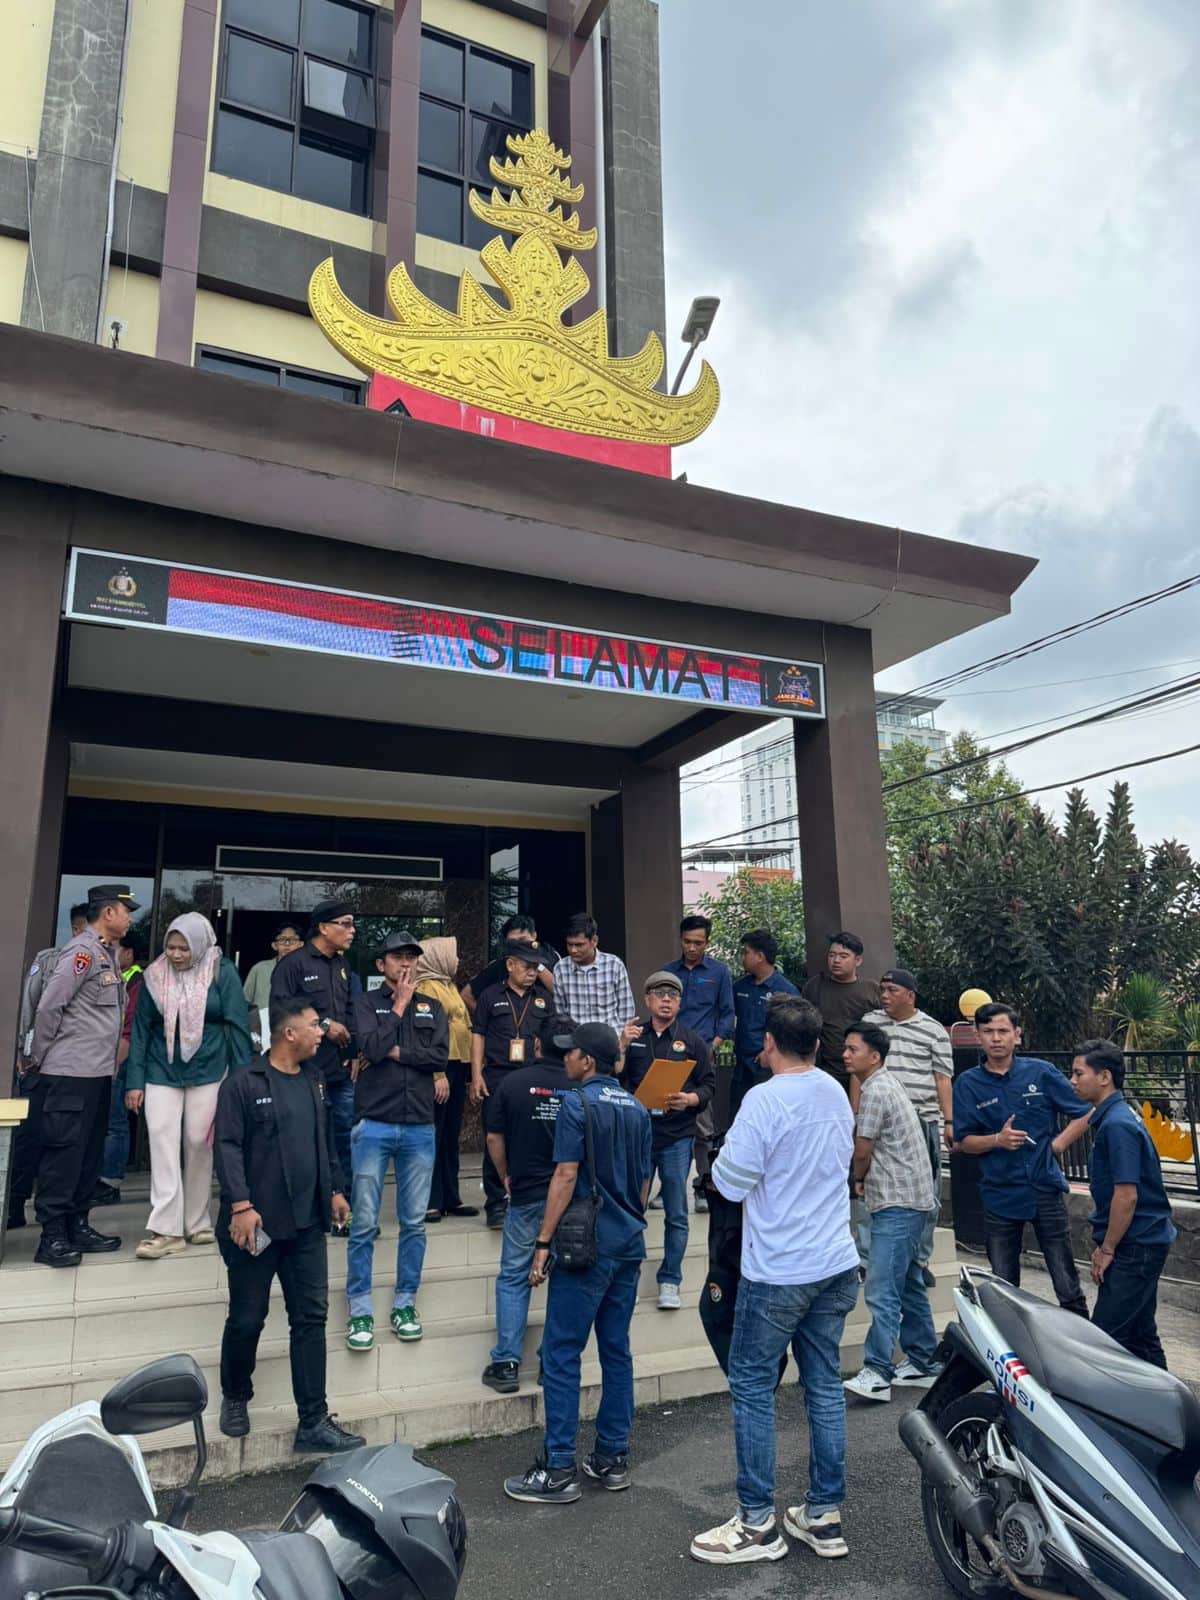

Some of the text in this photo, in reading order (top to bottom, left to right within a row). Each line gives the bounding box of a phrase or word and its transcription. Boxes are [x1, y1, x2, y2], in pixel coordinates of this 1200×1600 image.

[467, 618, 744, 702] SELAMAT
[986, 1349, 1035, 1412] POLISI
[346, 1478, 384, 1512] HONDA
